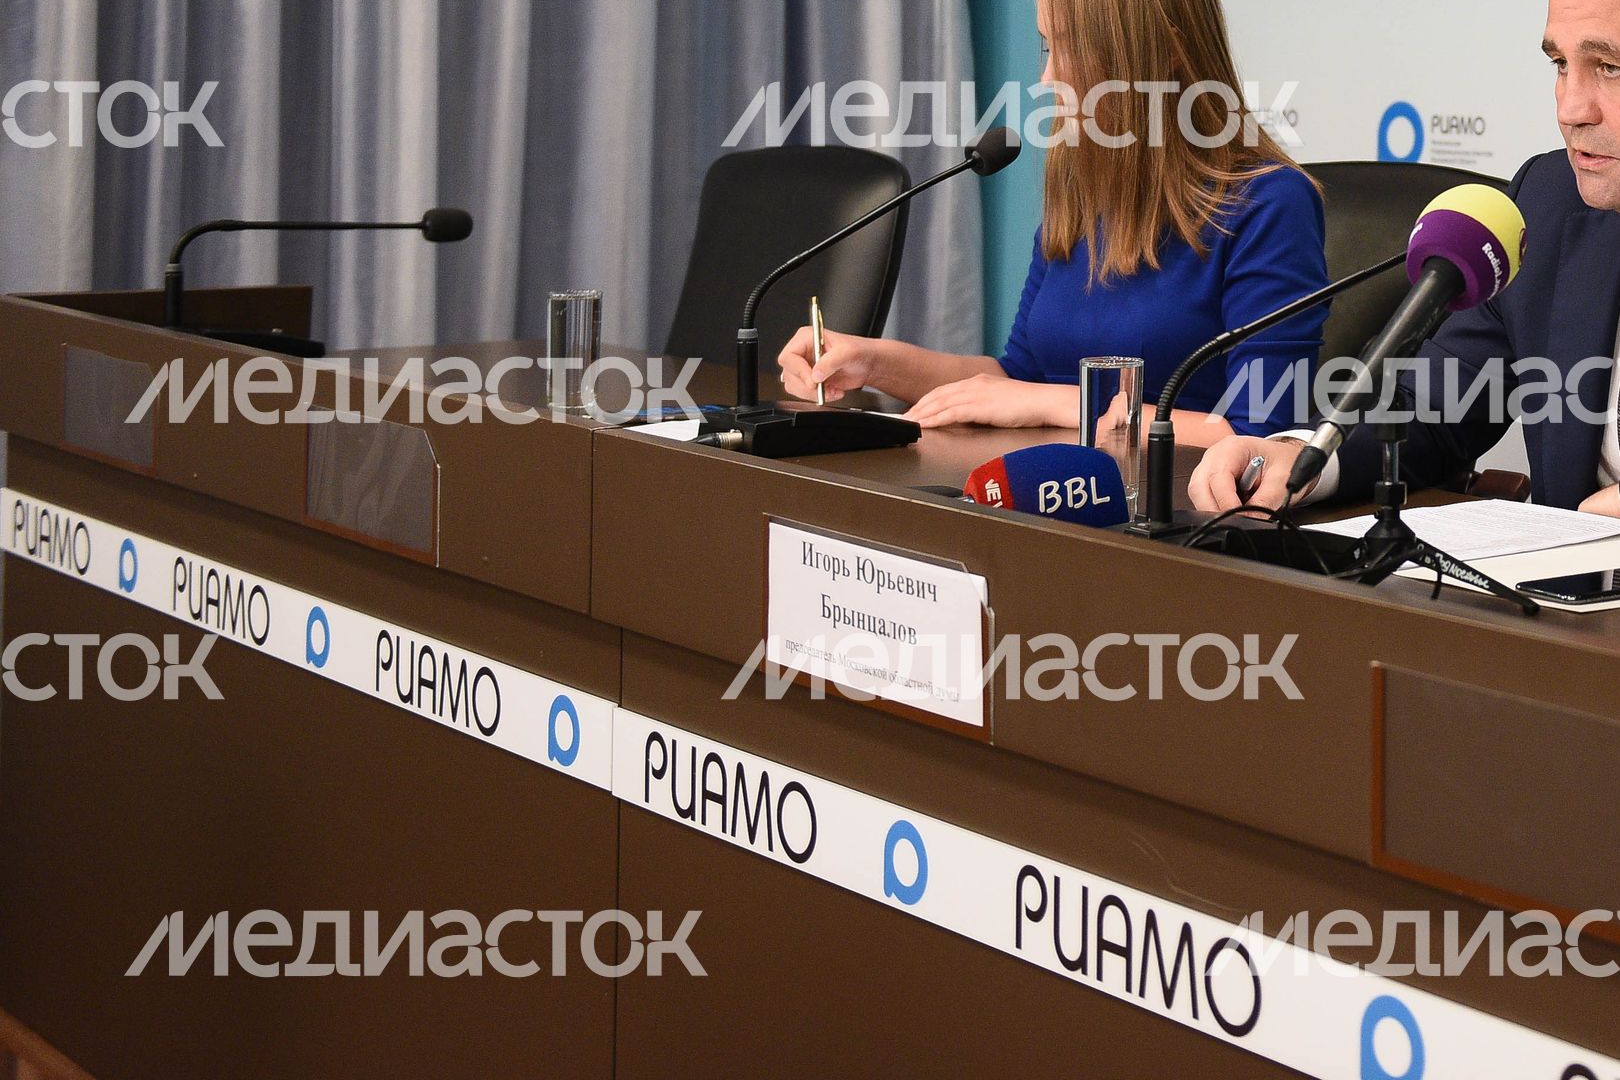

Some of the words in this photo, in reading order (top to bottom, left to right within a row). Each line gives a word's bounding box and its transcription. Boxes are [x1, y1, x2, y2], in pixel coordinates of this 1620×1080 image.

[1431, 115, 1486, 136] РИАМО
[1039, 476, 1111, 513] BBL
[13, 499, 91, 576] РИАМО
[801, 540, 850, 581] Игорь
[855, 555, 938, 602] Юрьевич
[173, 556, 270, 646] РИАМО
[820, 593, 917, 645] Брынцалов
[376, 629, 501, 737] РИАМО
[645, 730, 817, 864] РИАМО
[1015, 864, 1262, 1038] РИАМО
